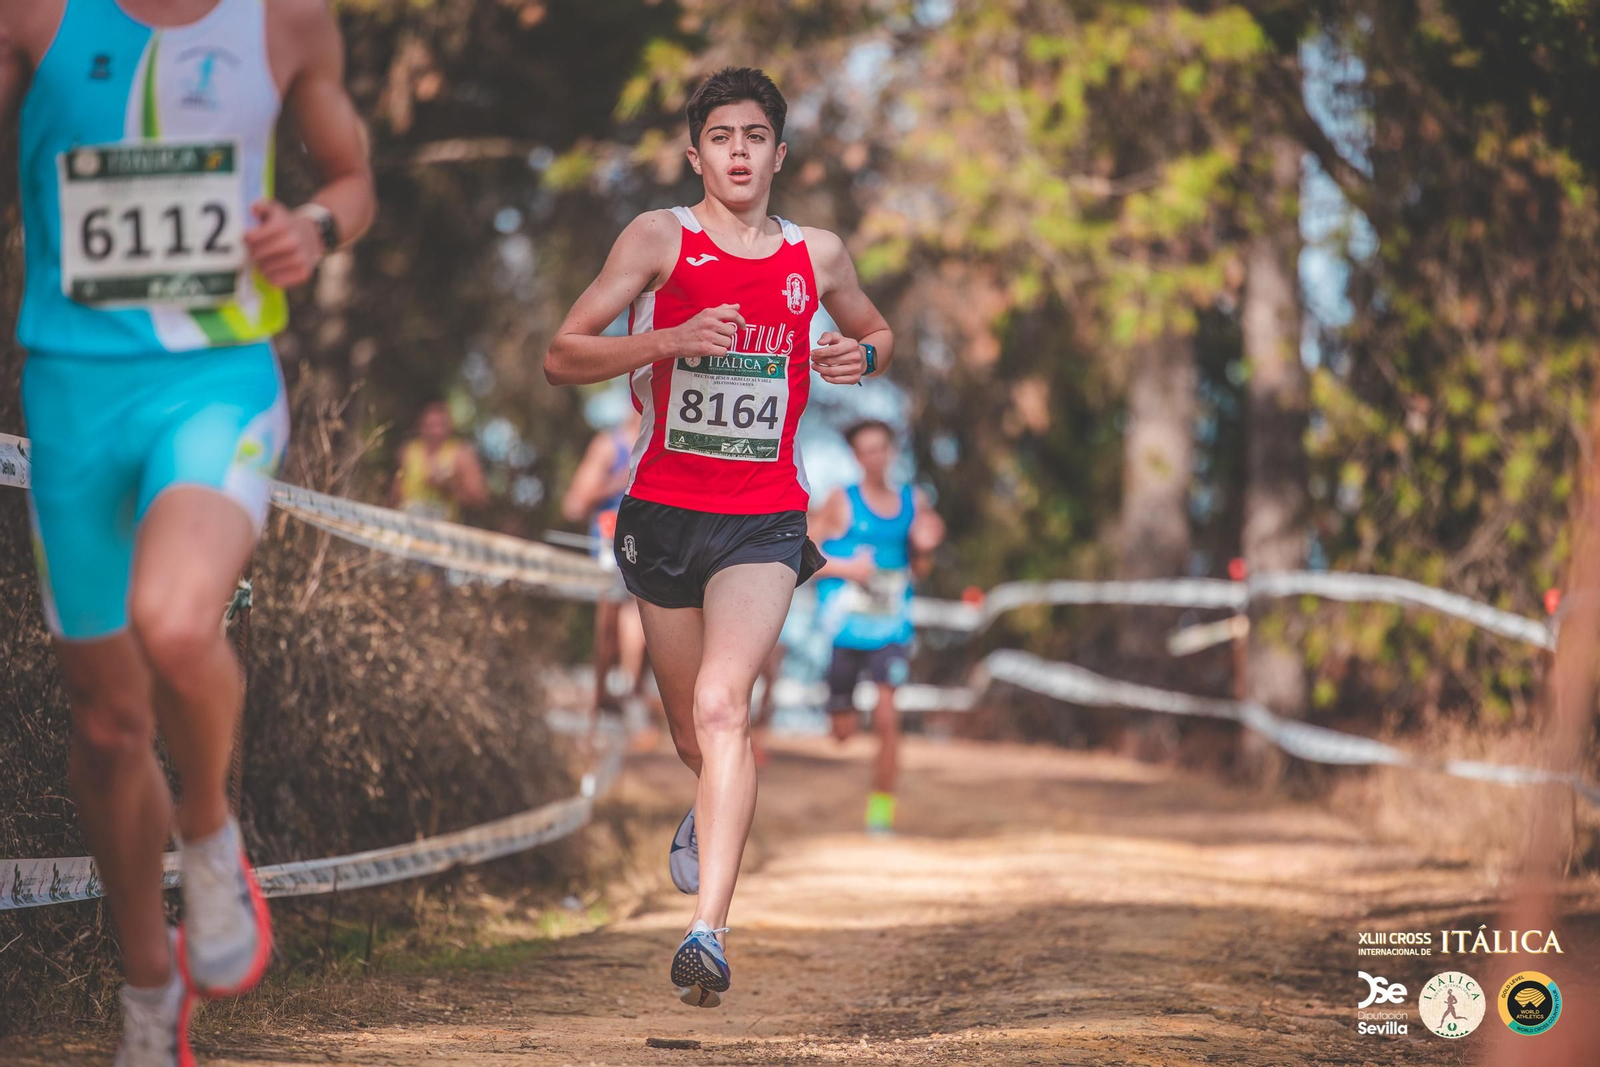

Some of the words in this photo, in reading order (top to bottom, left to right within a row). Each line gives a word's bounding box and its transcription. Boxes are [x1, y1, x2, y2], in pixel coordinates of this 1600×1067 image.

[81, 202, 231, 262] 6112
[708, 353, 762, 370] ITÁLICA
[680, 389, 778, 430] 8164
